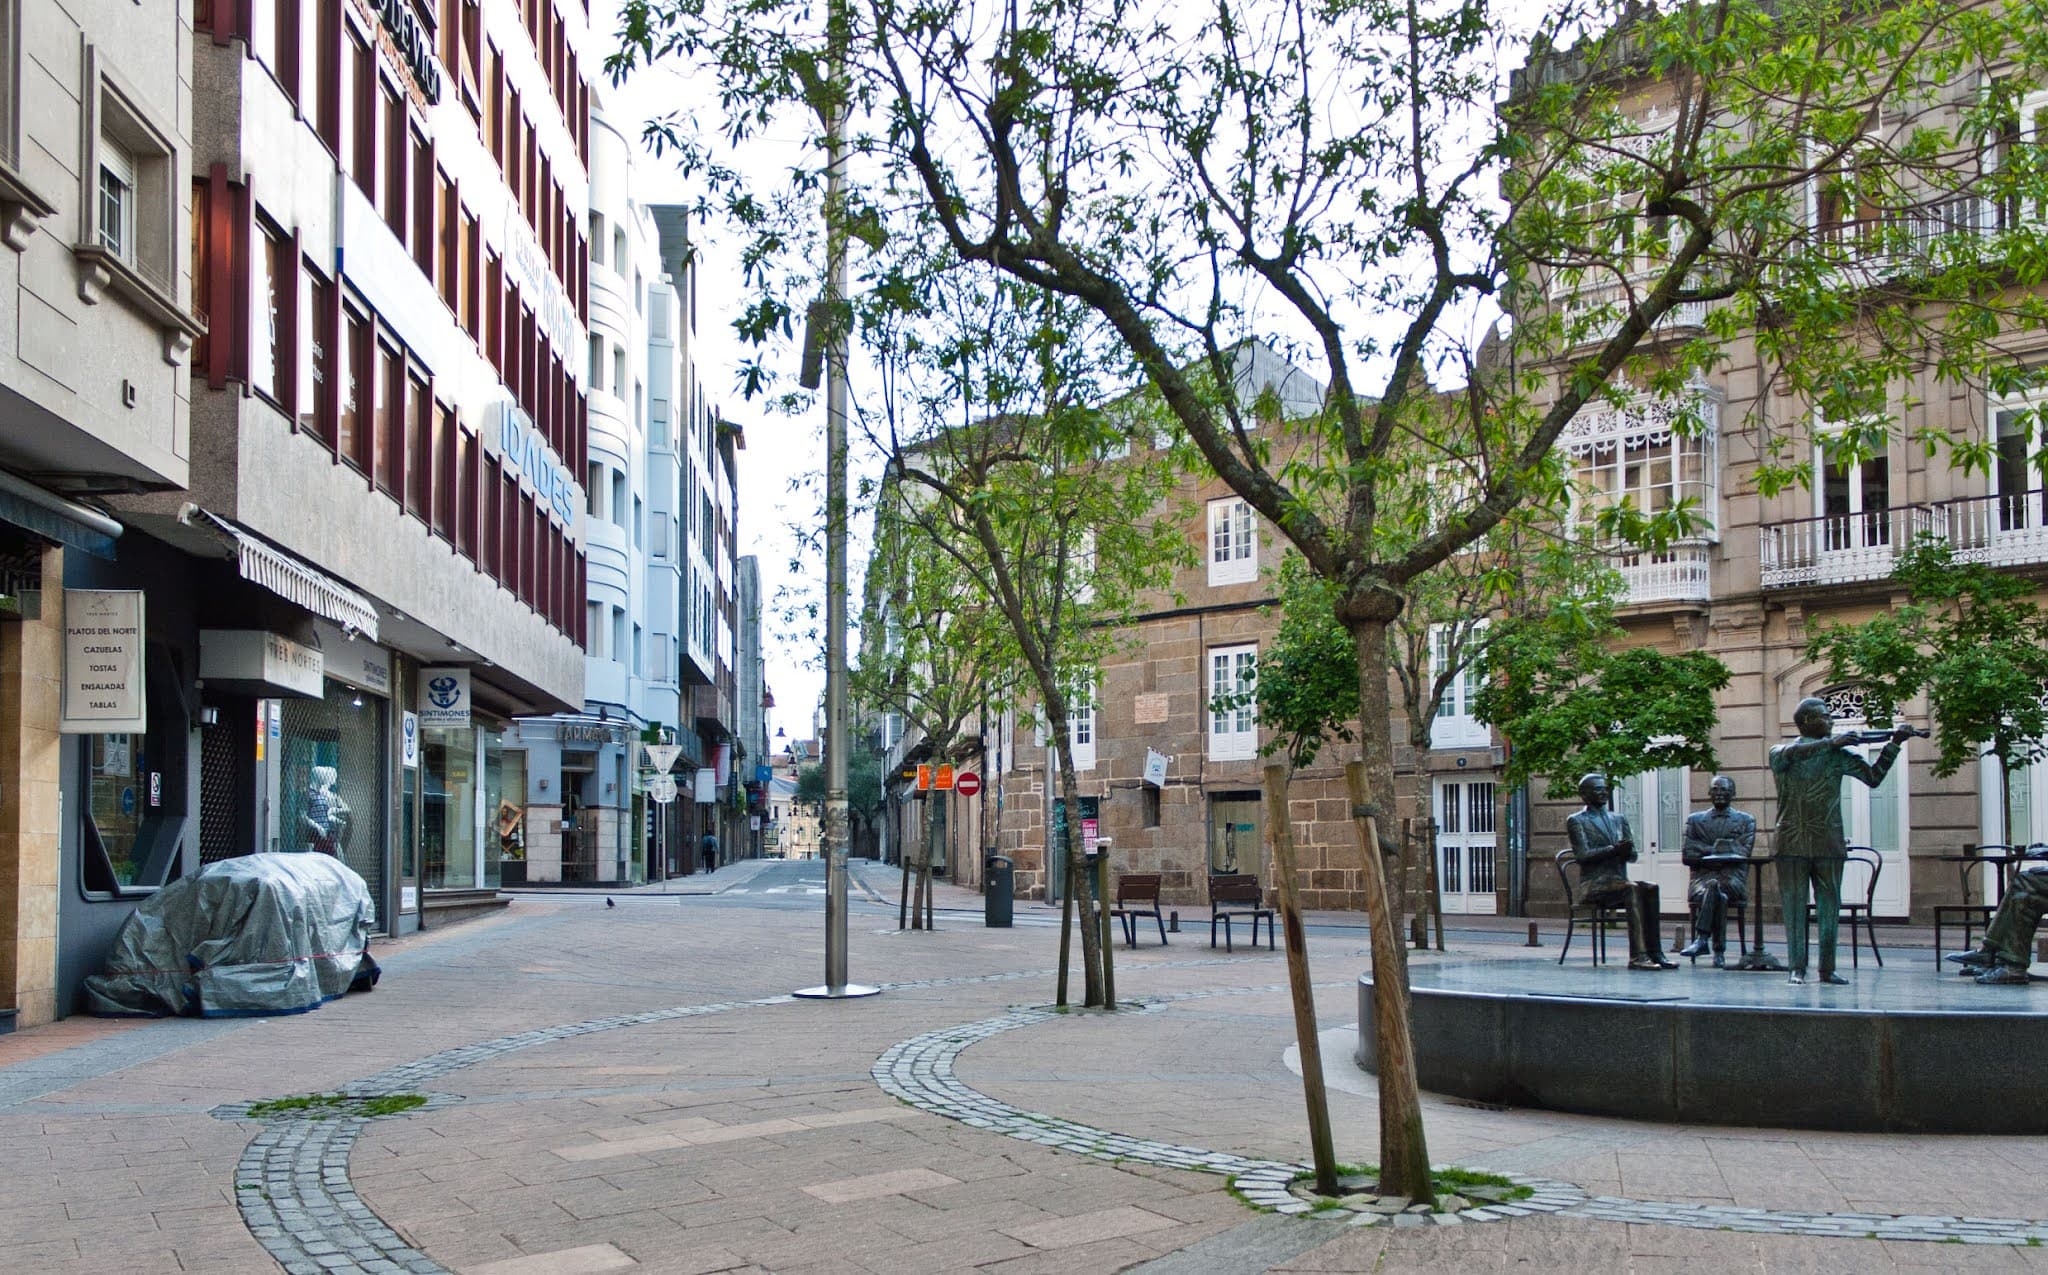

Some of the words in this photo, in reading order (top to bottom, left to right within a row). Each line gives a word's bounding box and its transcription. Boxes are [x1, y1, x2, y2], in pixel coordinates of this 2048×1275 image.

[113, 627, 137, 635] NORTE
[83, 646, 123, 654] CAZUELAS
[269, 641, 289, 662] TRES
[291, 652, 321, 674] NORTES
[81, 683, 126, 691] ENSALADAS
